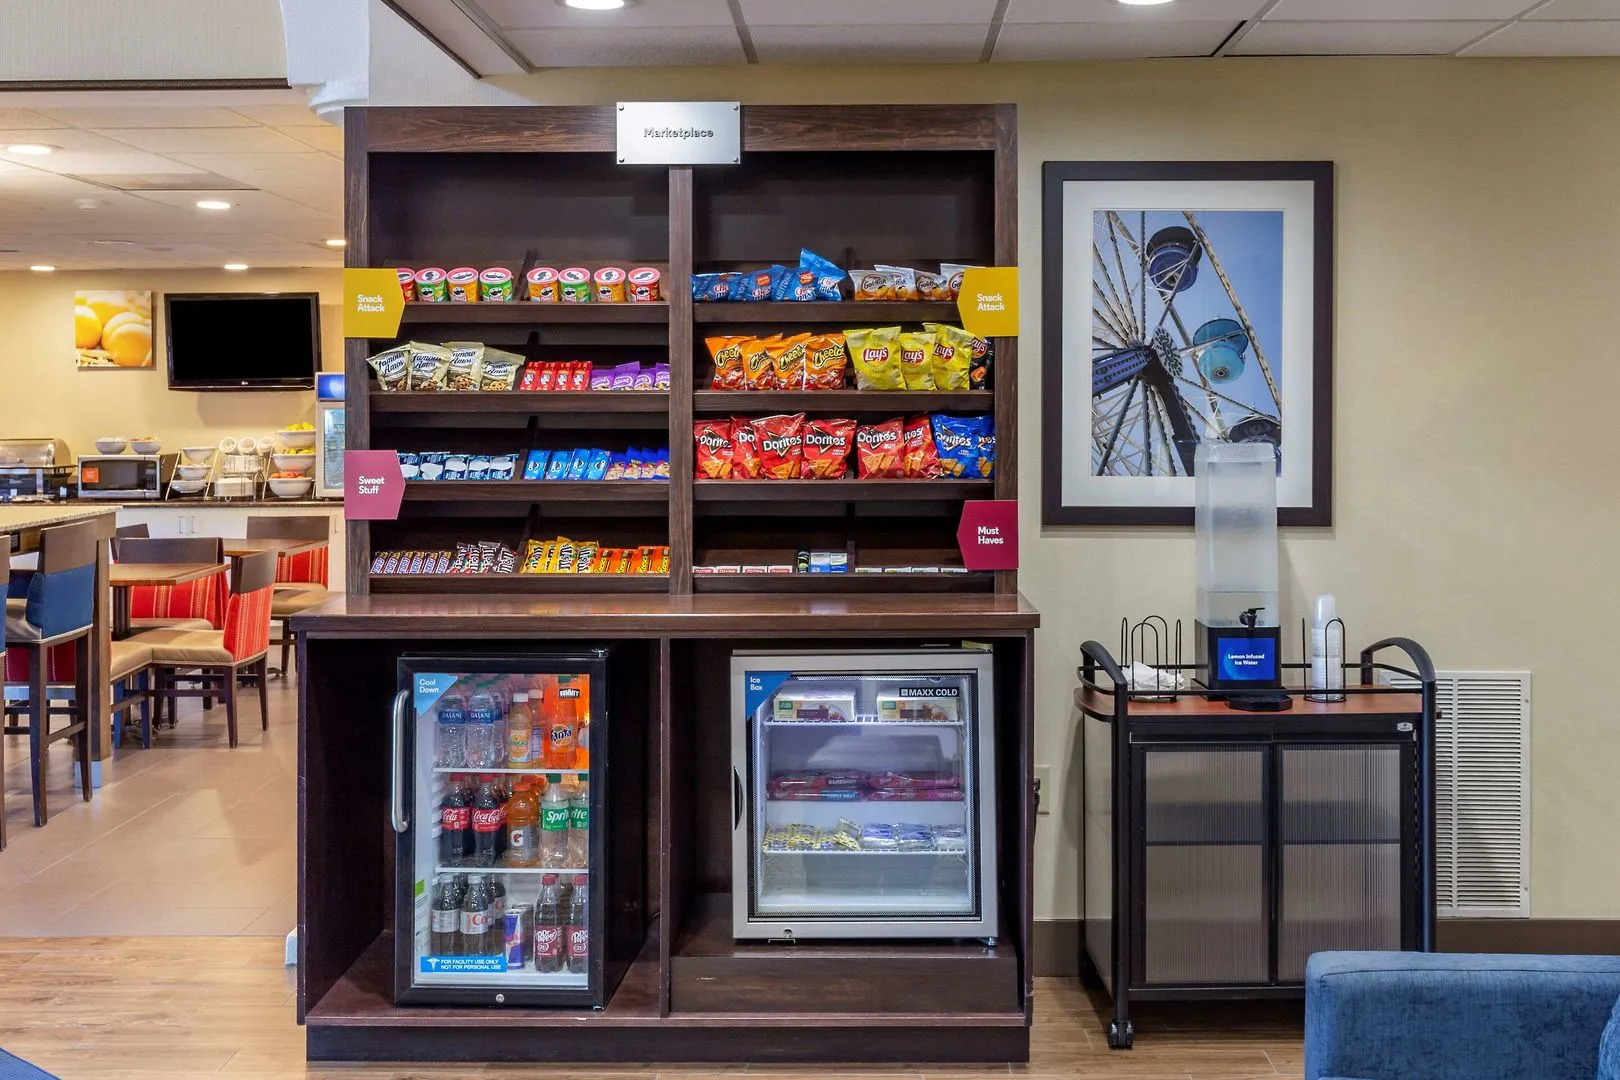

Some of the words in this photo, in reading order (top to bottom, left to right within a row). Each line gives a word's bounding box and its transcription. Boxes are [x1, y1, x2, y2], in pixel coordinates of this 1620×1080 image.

[644, 127, 714, 140] Marketplace
[357, 294, 383, 303] Snack
[977, 294, 1003, 302] Snack
[357, 303, 385, 312] Attack
[977, 302, 1005, 311] Attack
[864, 347, 888, 361] Lay's
[377, 351, 405, 372] Famous
[384, 360, 404, 375] Amos
[806, 434, 846, 446] Doritos
[858, 432, 897, 443] Doritos
[936, 432, 972, 447] Doritos
[763, 436, 802, 451] Doritos
[358, 476, 385, 485] Sweet
[358, 485, 379, 494] Stuff
[977, 526, 1000, 535] Must
[977, 535, 1004, 545] Haves
